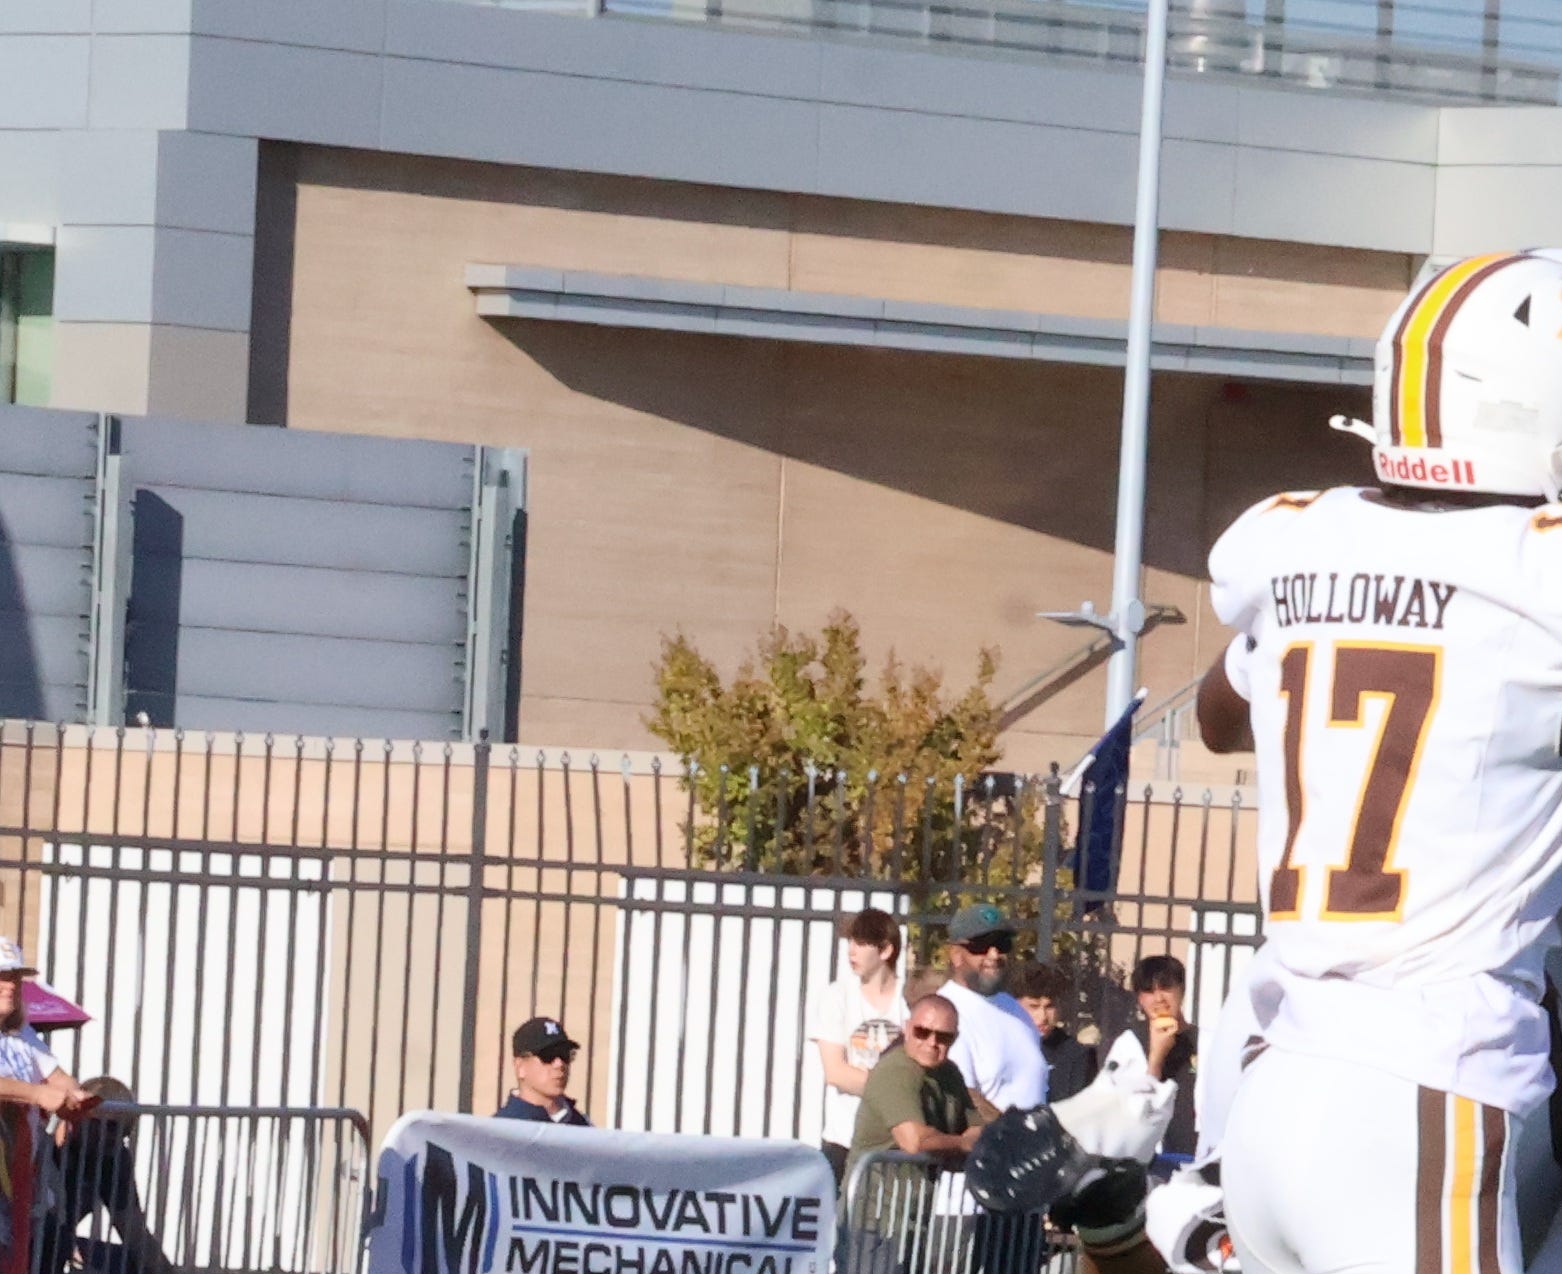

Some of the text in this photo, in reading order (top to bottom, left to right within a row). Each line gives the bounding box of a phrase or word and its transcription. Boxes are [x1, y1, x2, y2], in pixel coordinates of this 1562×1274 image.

[1377, 452, 1476, 485] Riddell
[1271, 573, 1457, 631] HOLLOWAY
[1267, 639, 1444, 922] 17
[508, 1175, 821, 1241] INNOVATIVE
